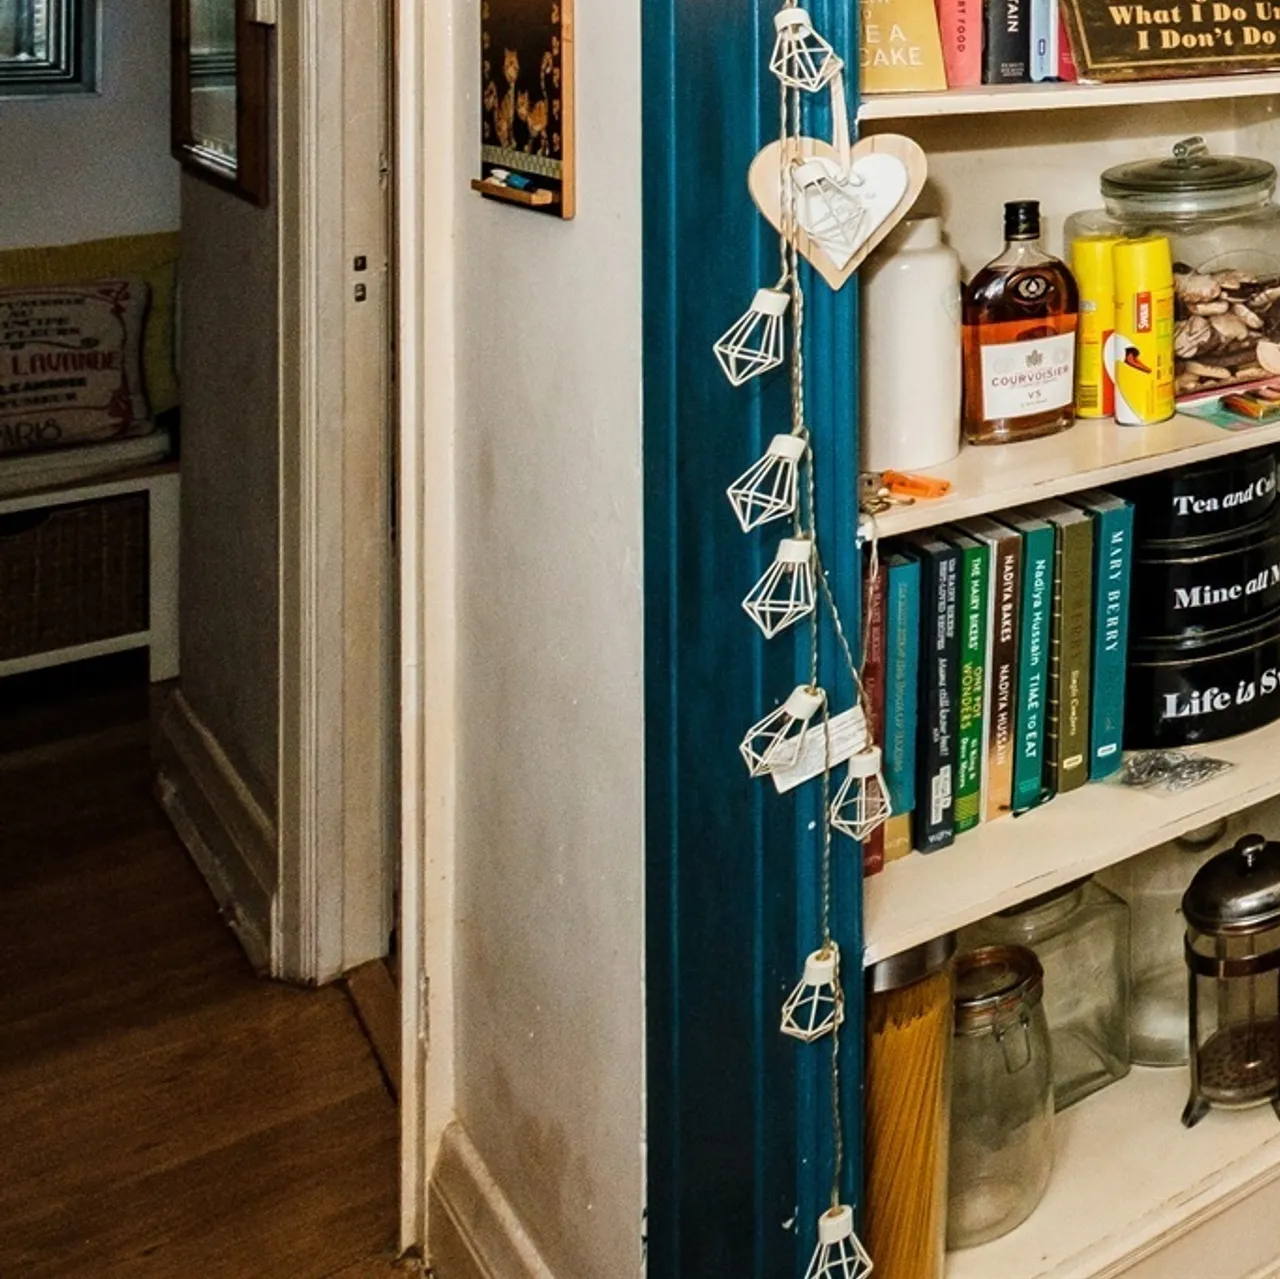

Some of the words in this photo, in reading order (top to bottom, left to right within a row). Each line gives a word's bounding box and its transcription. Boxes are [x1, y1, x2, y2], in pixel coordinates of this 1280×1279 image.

[1107, 4, 1182, 26] What
[1190, 3, 1203, 23] I
[1212, 2, 1248, 22] Do
[956, 19, 968, 53] FOOD
[1136, 29, 1150, 51] I
[1160, 27, 1234, 51] Don't
[1242, 25, 1277, 46] Do
[11, 351, 122, 377] LAVANDE
[990, 363, 1071, 389] COURVOISIER
[0, 417, 62, 448] ARIS
[1172, 495, 1220, 517] Tea
[1221, 483, 1255, 509] and
[971, 557, 982, 578] THE
[1108, 529, 1124, 581] MARY
[970, 579, 981, 611] HAIRY
[1002, 554, 1015, 602] NADIYA
[1032, 558, 1047, 609] Nadiya
[1172, 583, 1243, 610] Mine
[1244, 569, 1269, 596] all
[1001, 602, 1013, 643] BAKES
[1105, 589, 1121, 652] BERRY
[1030, 610, 1044, 667] Hussain
[958, 661, 973, 730] WONDERS
[973, 665, 983, 692] ONE
[998, 663, 1010, 711] NADIYA
[1027, 672, 1041, 711] TIME
[972, 695, 983, 718] POT
[1161, 686, 1232, 719] Life
[1235, 679, 1256, 706] is
[996, 711, 1010, 766] HUSSAIN
[1027, 714, 1038, 730] TO
[1025, 731, 1039, 758] EAT
